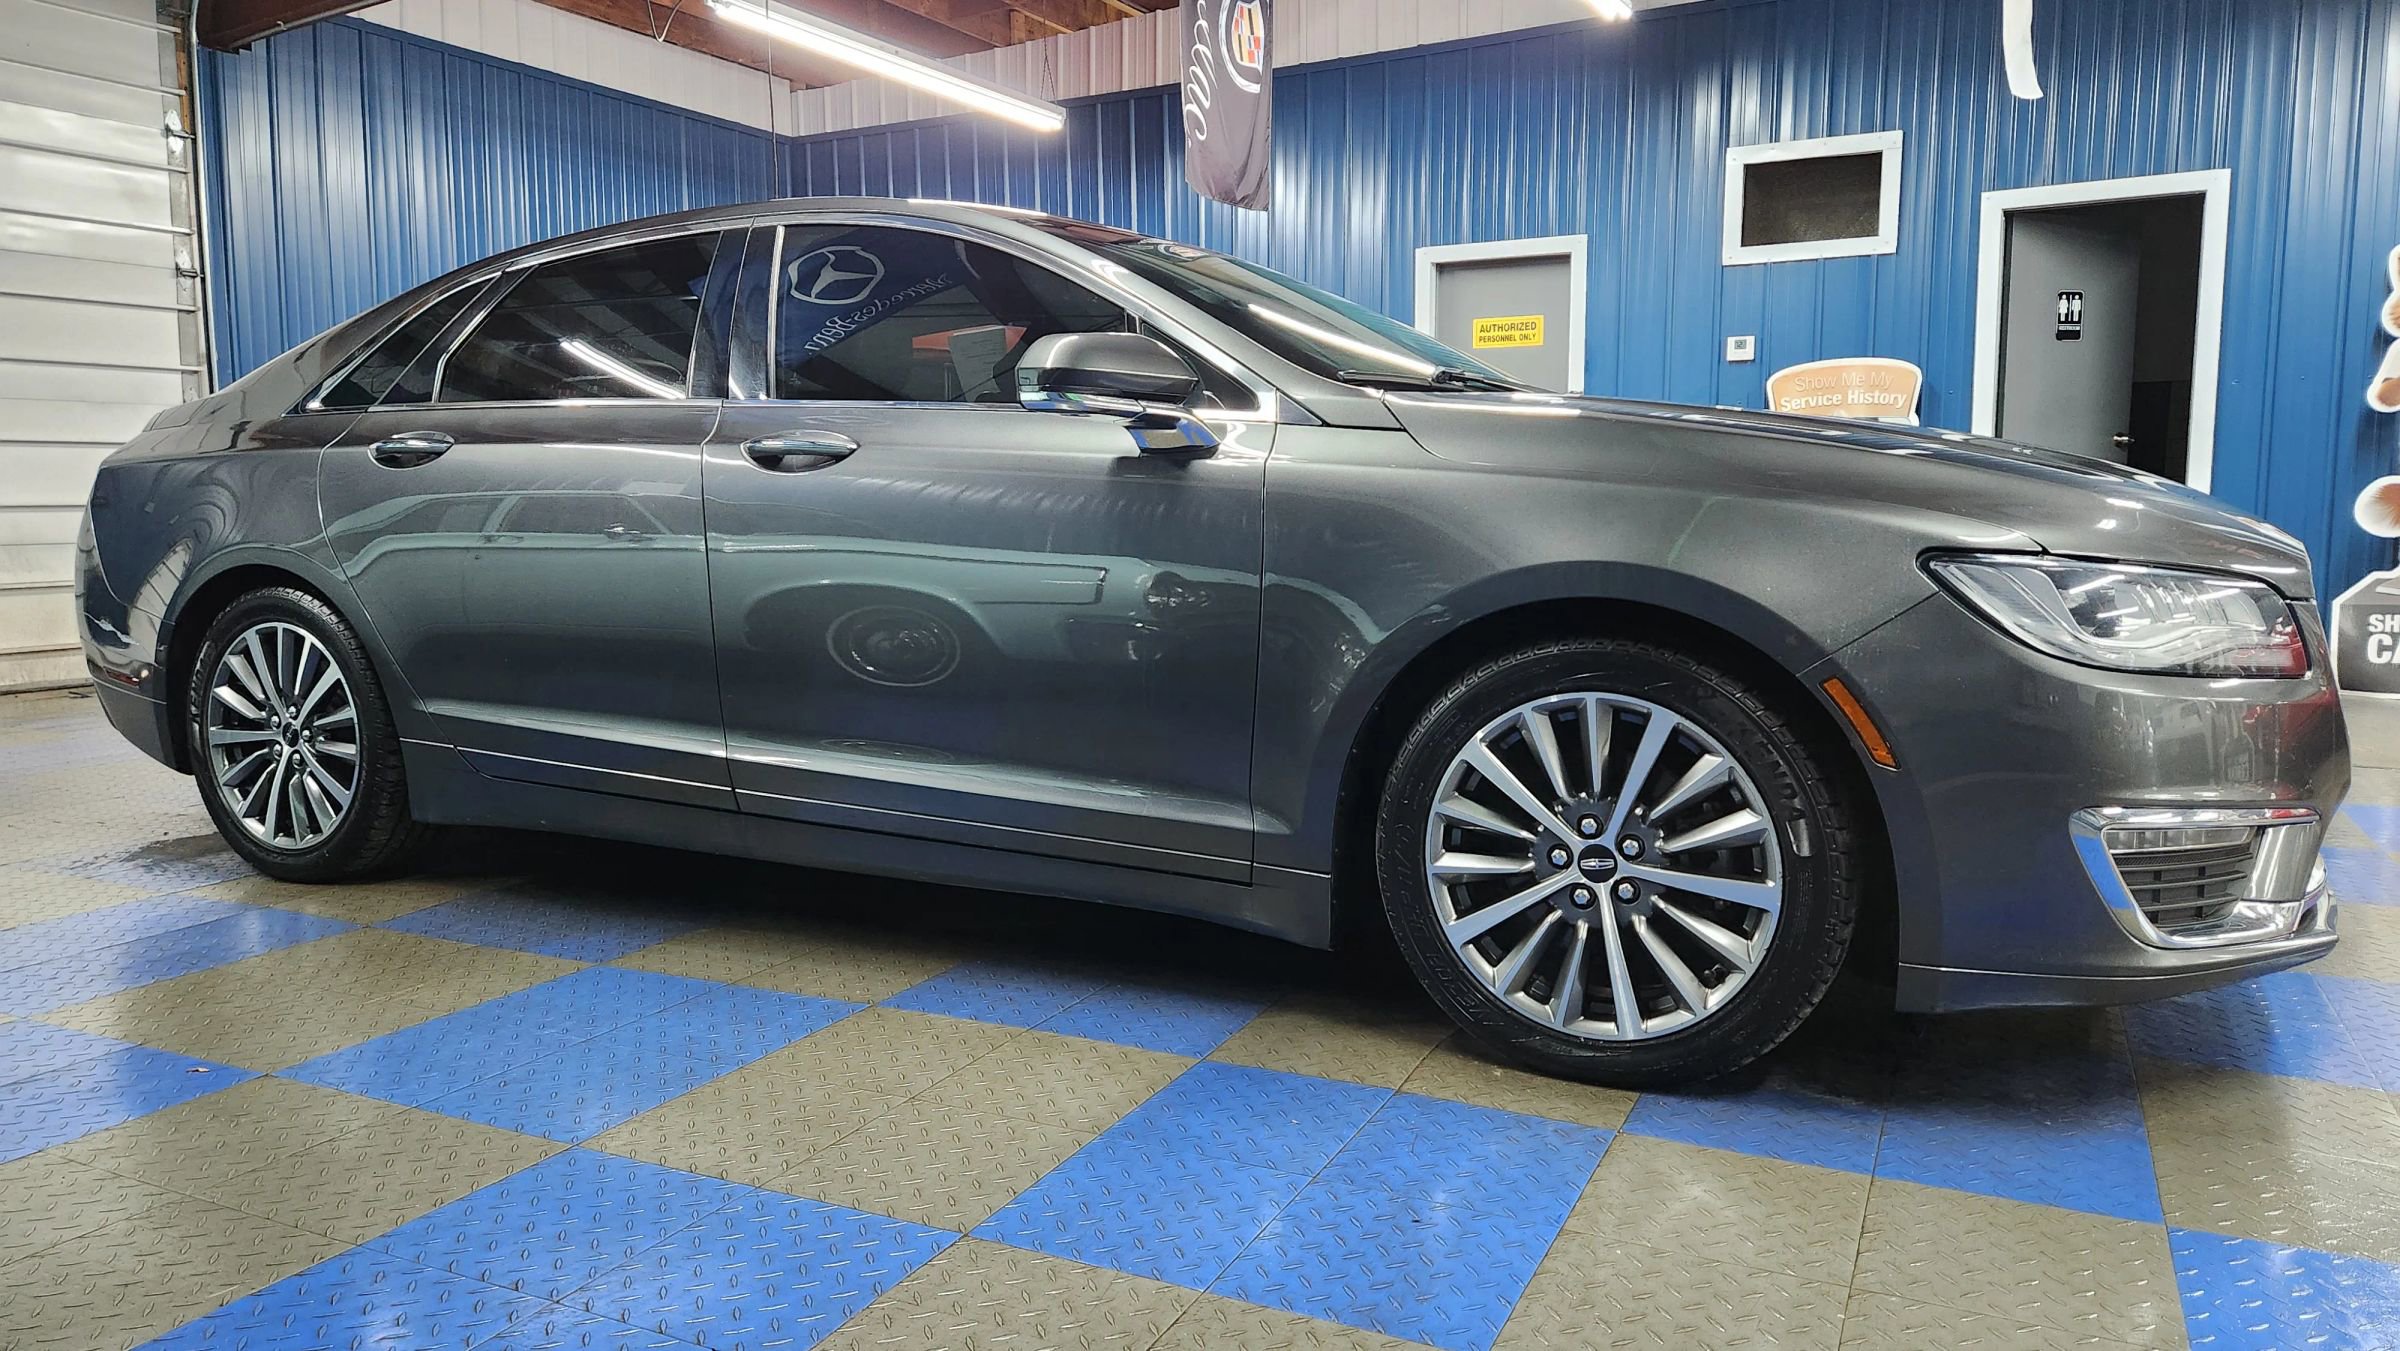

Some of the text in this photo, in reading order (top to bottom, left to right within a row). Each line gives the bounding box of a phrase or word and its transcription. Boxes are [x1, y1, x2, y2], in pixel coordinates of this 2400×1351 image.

[1479, 321, 1537, 333] AUTHORIZED
[1478, 333, 1536, 343] PERSONNEL ONLY
[1795, 371, 1894, 391] Show Me My
[1780, 390, 1907, 412] Service History
